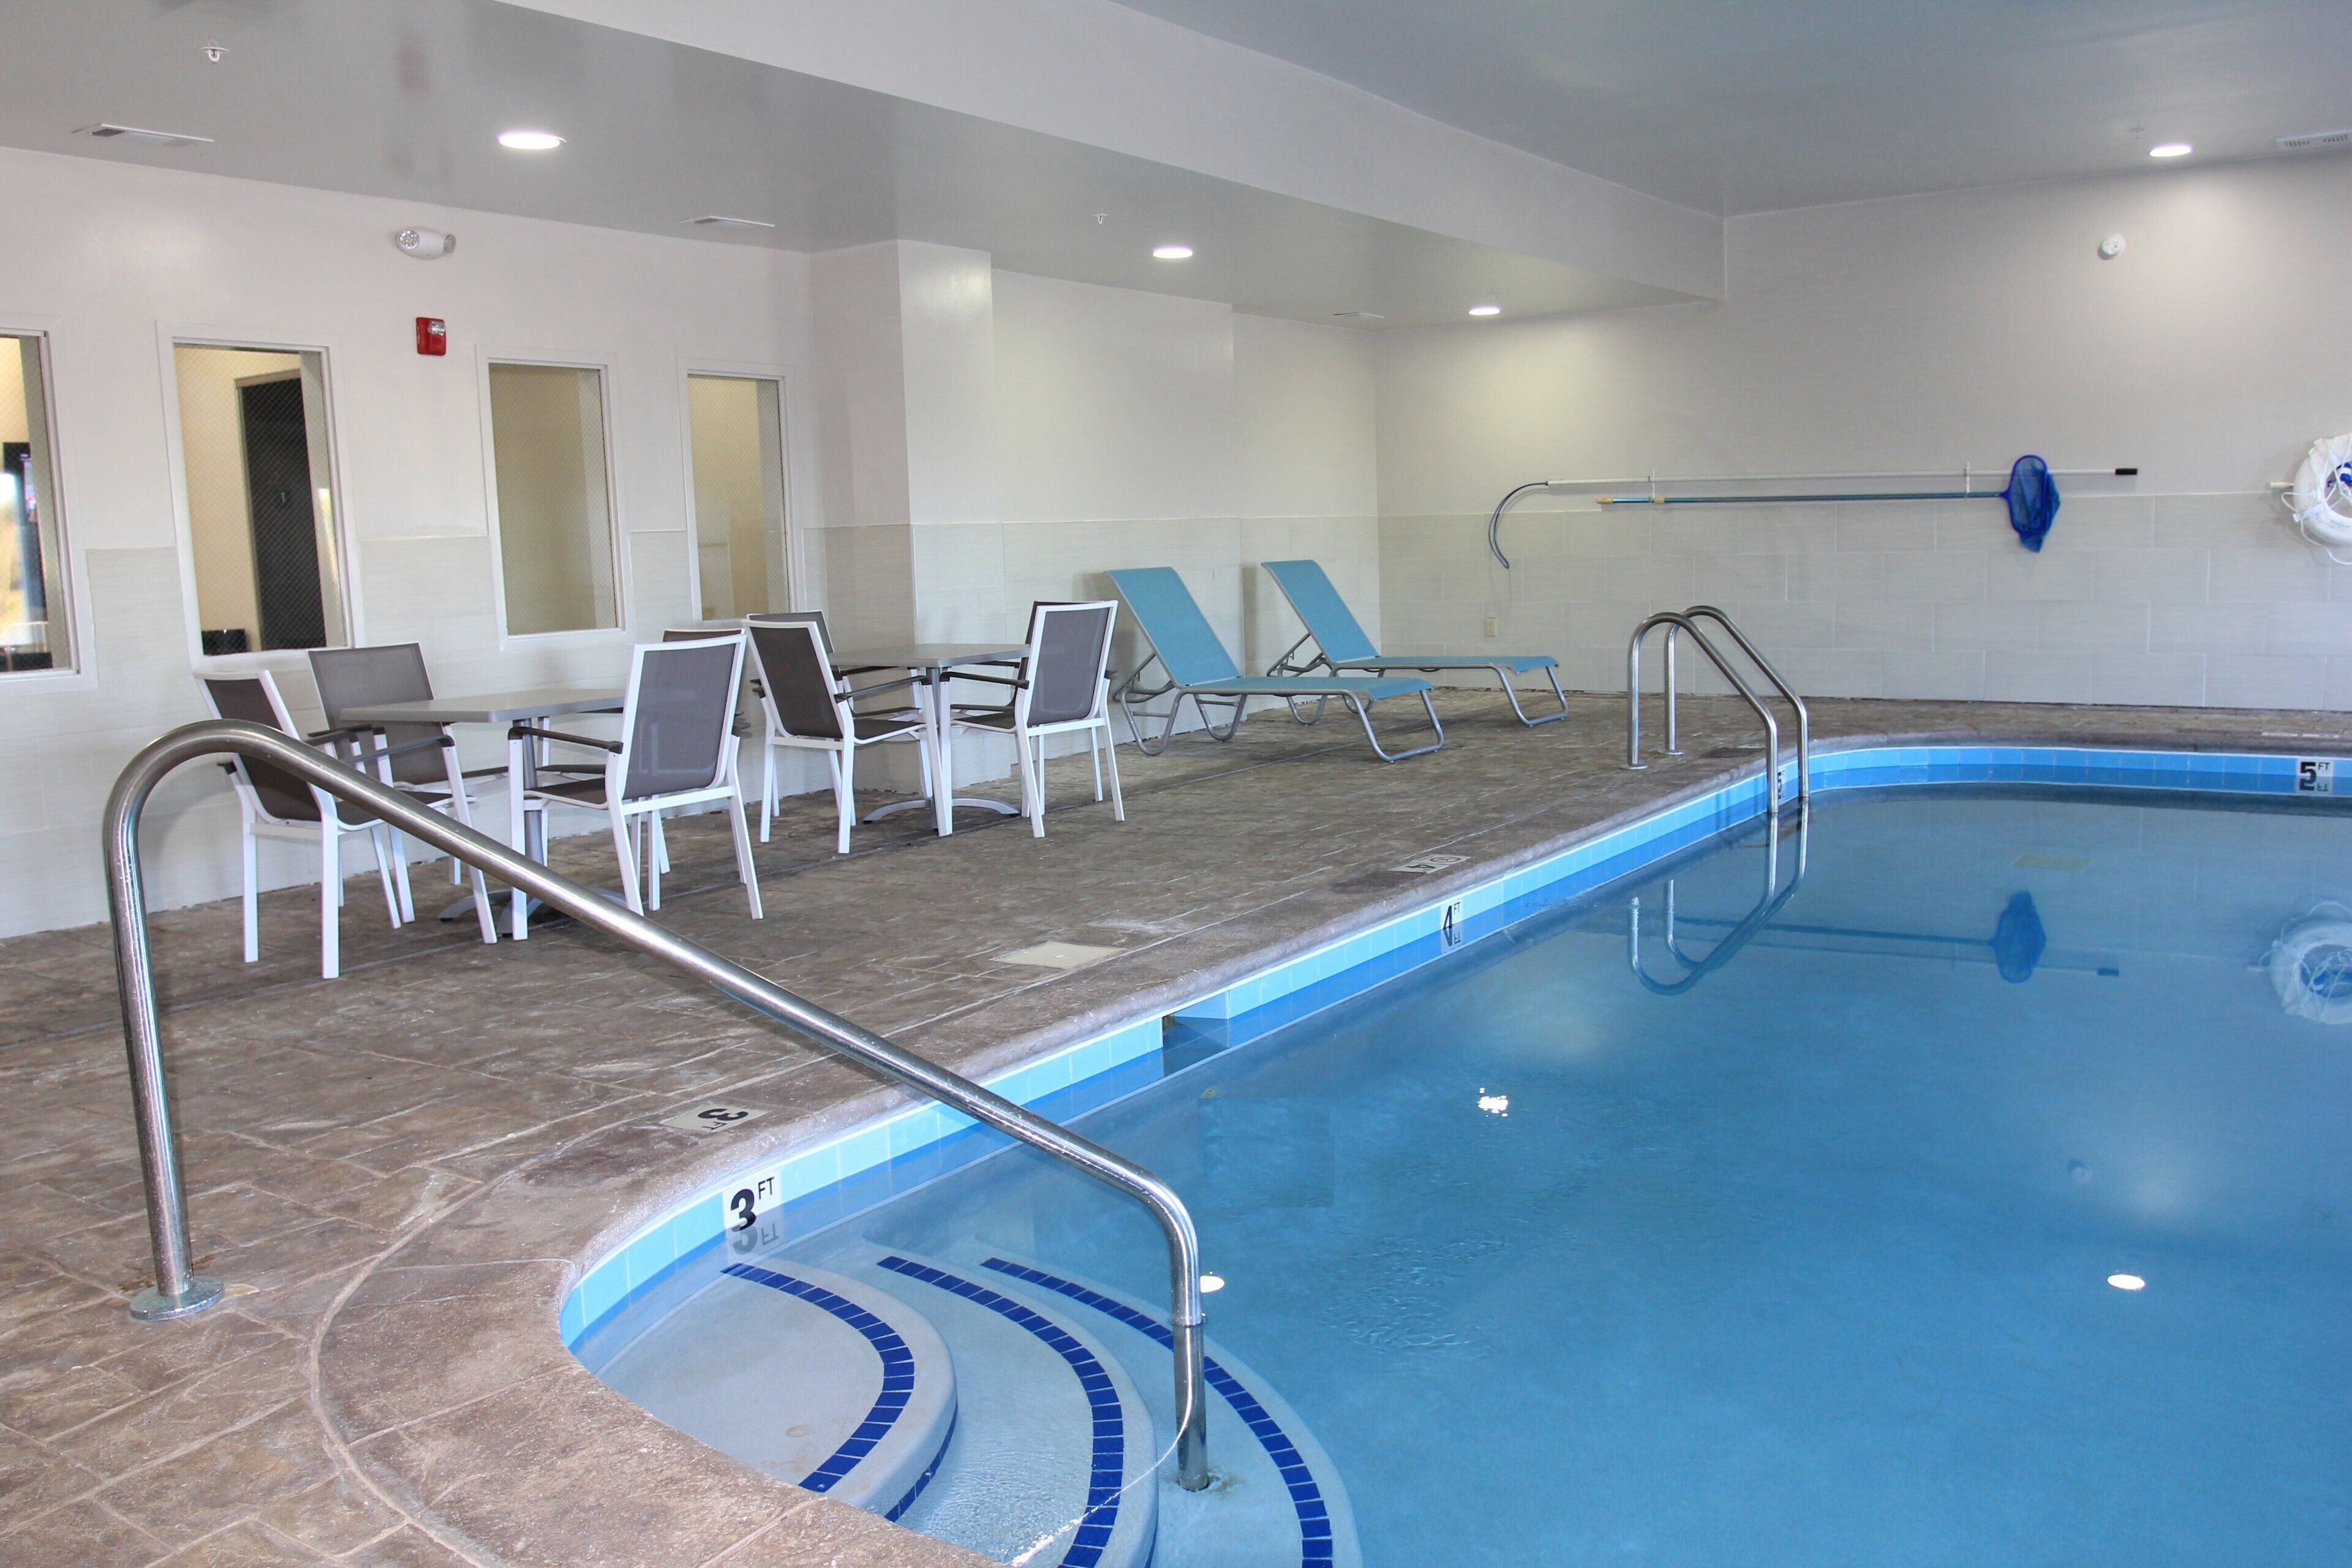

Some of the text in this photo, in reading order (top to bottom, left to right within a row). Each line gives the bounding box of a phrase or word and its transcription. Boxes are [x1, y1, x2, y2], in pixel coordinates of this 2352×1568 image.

[2300, 762, 2316, 785] 5
[1443, 902, 1461, 930] 4 FT
[698, 1109, 748, 1121] 3
[731, 1176, 775, 1232] 3 FT
